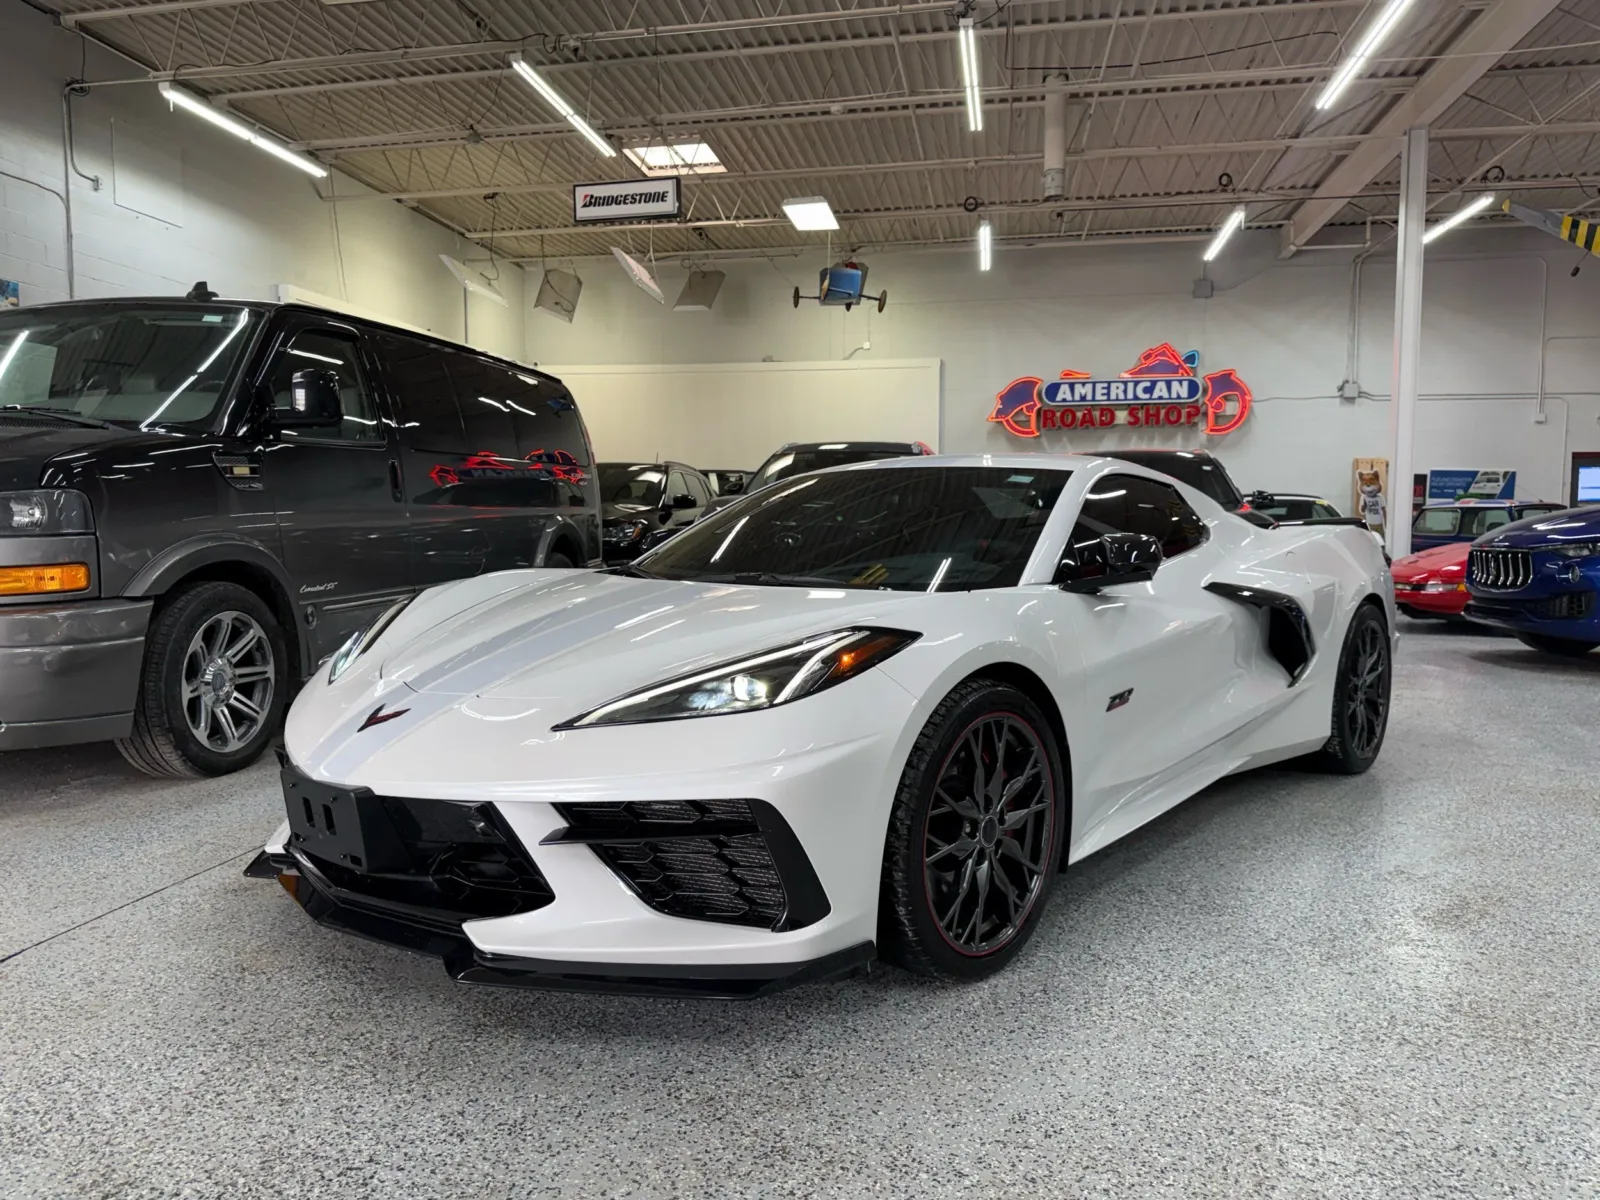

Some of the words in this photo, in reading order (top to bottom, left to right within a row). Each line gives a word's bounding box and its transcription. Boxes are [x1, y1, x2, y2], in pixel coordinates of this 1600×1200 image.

[581, 191, 669, 208] BRIDGESTONE
[1055, 380, 1189, 402] AMERICAN
[1041, 406, 1116, 429] ROAD
[1127, 405, 1200, 427] SHOP
